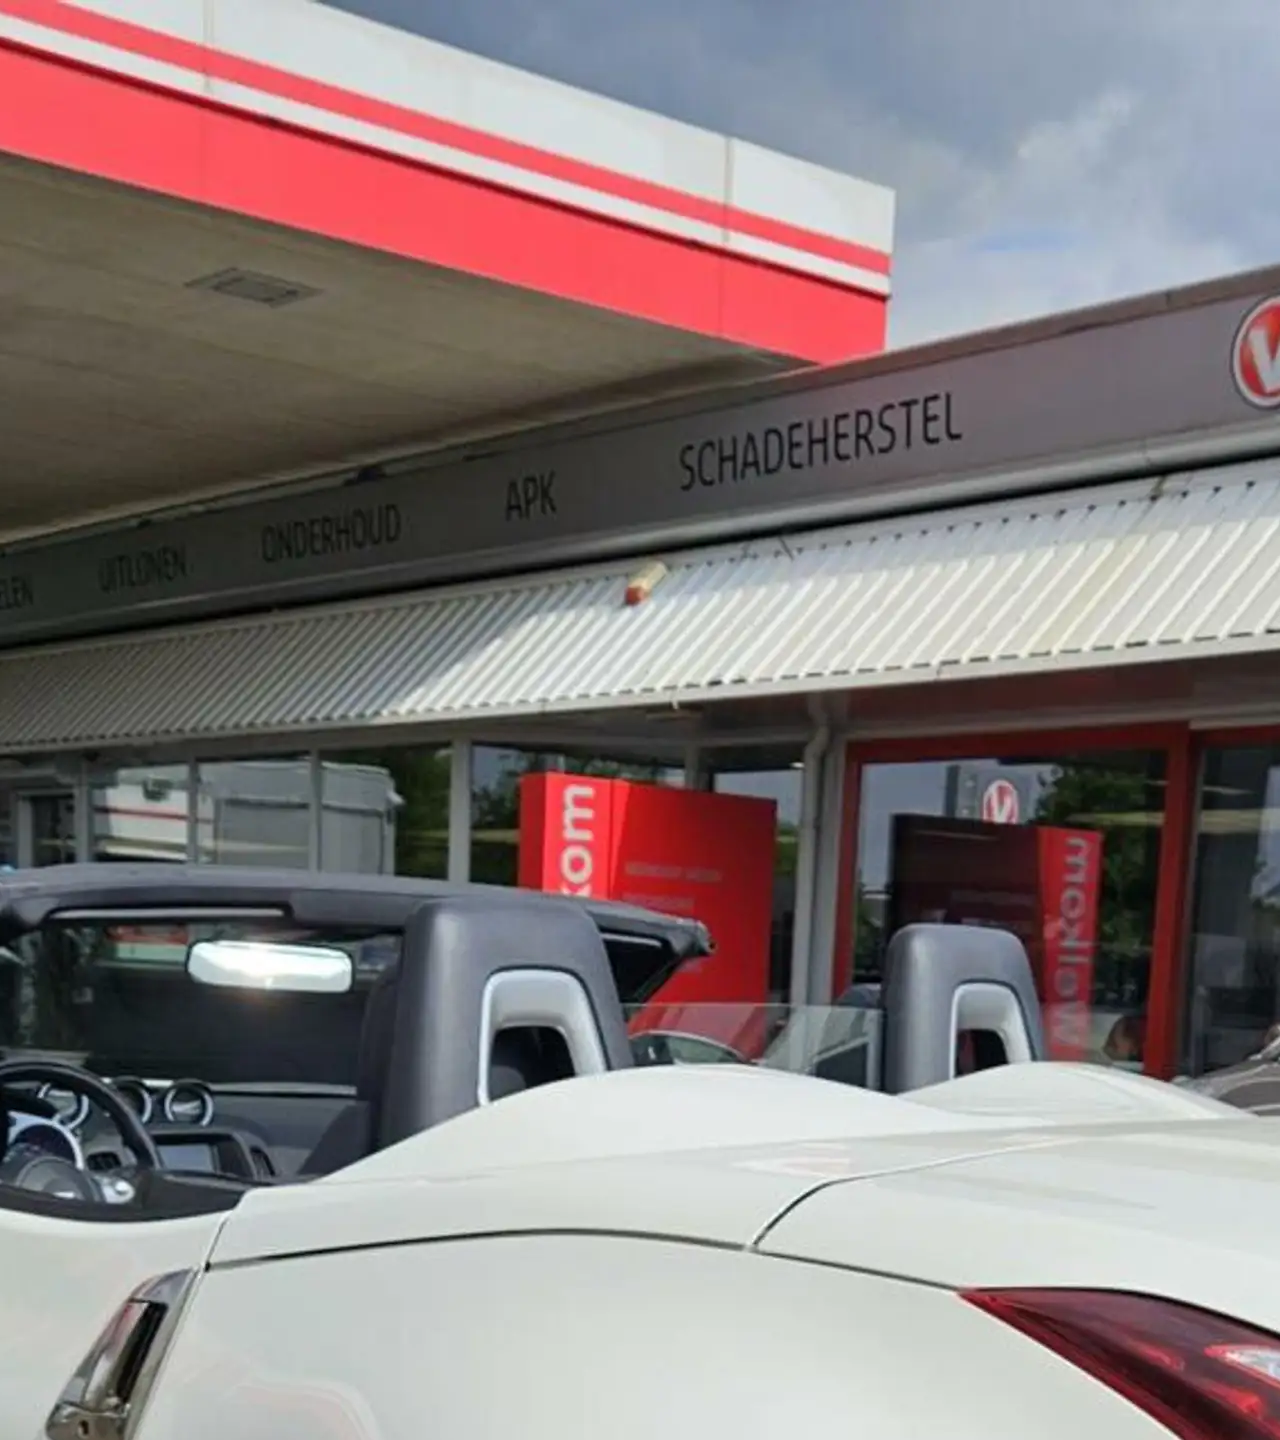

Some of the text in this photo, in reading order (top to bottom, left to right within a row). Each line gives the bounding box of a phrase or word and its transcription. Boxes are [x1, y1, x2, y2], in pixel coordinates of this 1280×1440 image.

[679, 392, 963, 491] SCHADEHERSTEL
[506, 470, 558, 521] APK
[261, 503, 402, 563] ONDERHOUD
